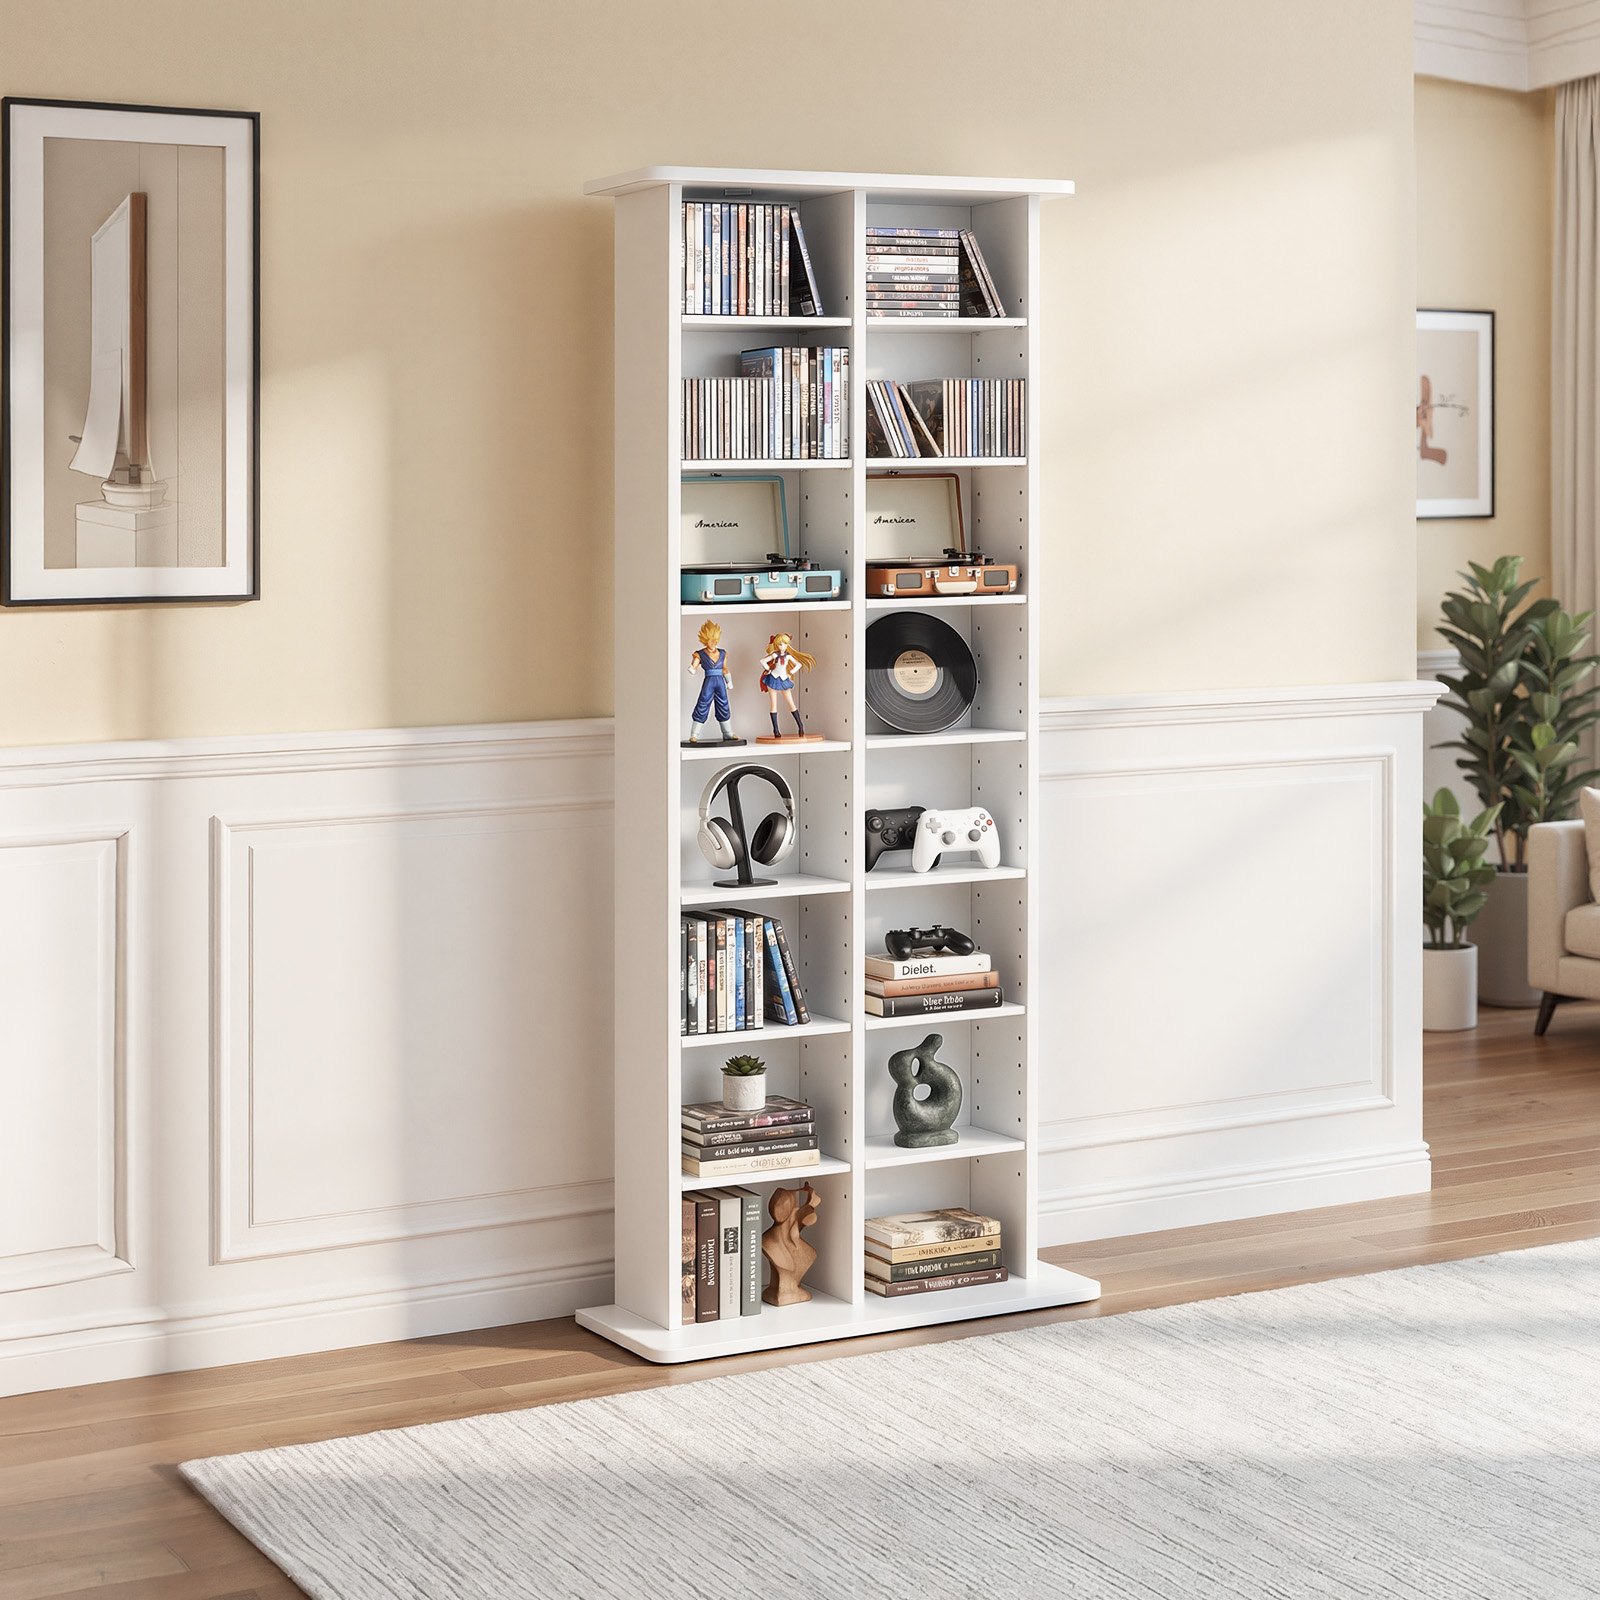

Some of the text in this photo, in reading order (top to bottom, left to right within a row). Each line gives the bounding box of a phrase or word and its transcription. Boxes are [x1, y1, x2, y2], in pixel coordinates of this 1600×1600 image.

[695, 519, 739, 529] American
[873, 515, 916, 525] American
[902, 964, 936, 975] Dielet.
